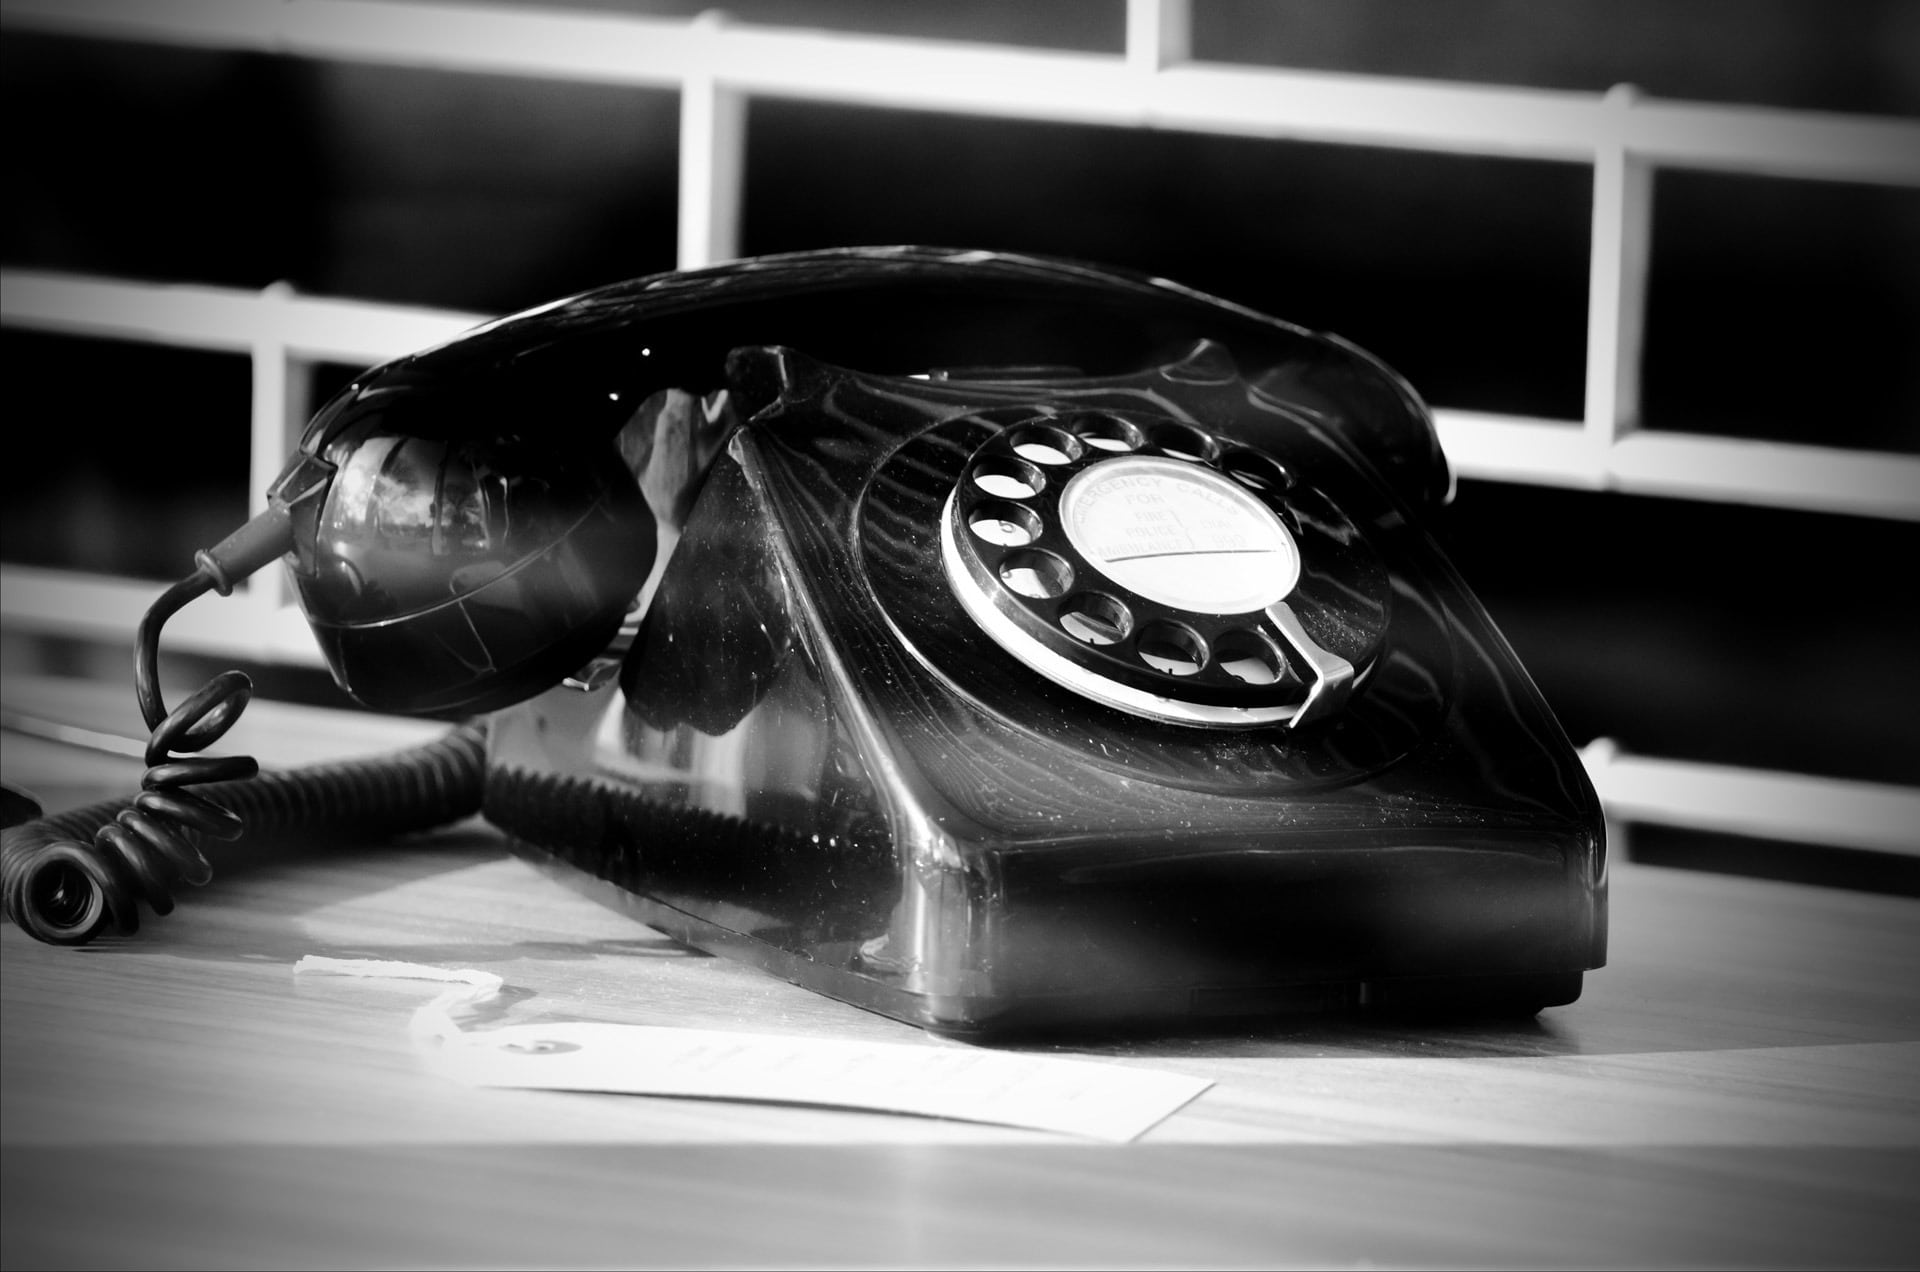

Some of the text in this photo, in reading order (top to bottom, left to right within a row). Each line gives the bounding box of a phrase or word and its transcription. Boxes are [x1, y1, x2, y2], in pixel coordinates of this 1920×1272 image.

[1124, 493, 1168, 505] FOR
[1175, 483, 1241, 516] CALLS
[1133, 510, 1170, 522] FIRE
[1124, 525, 1178, 537] POLICE
